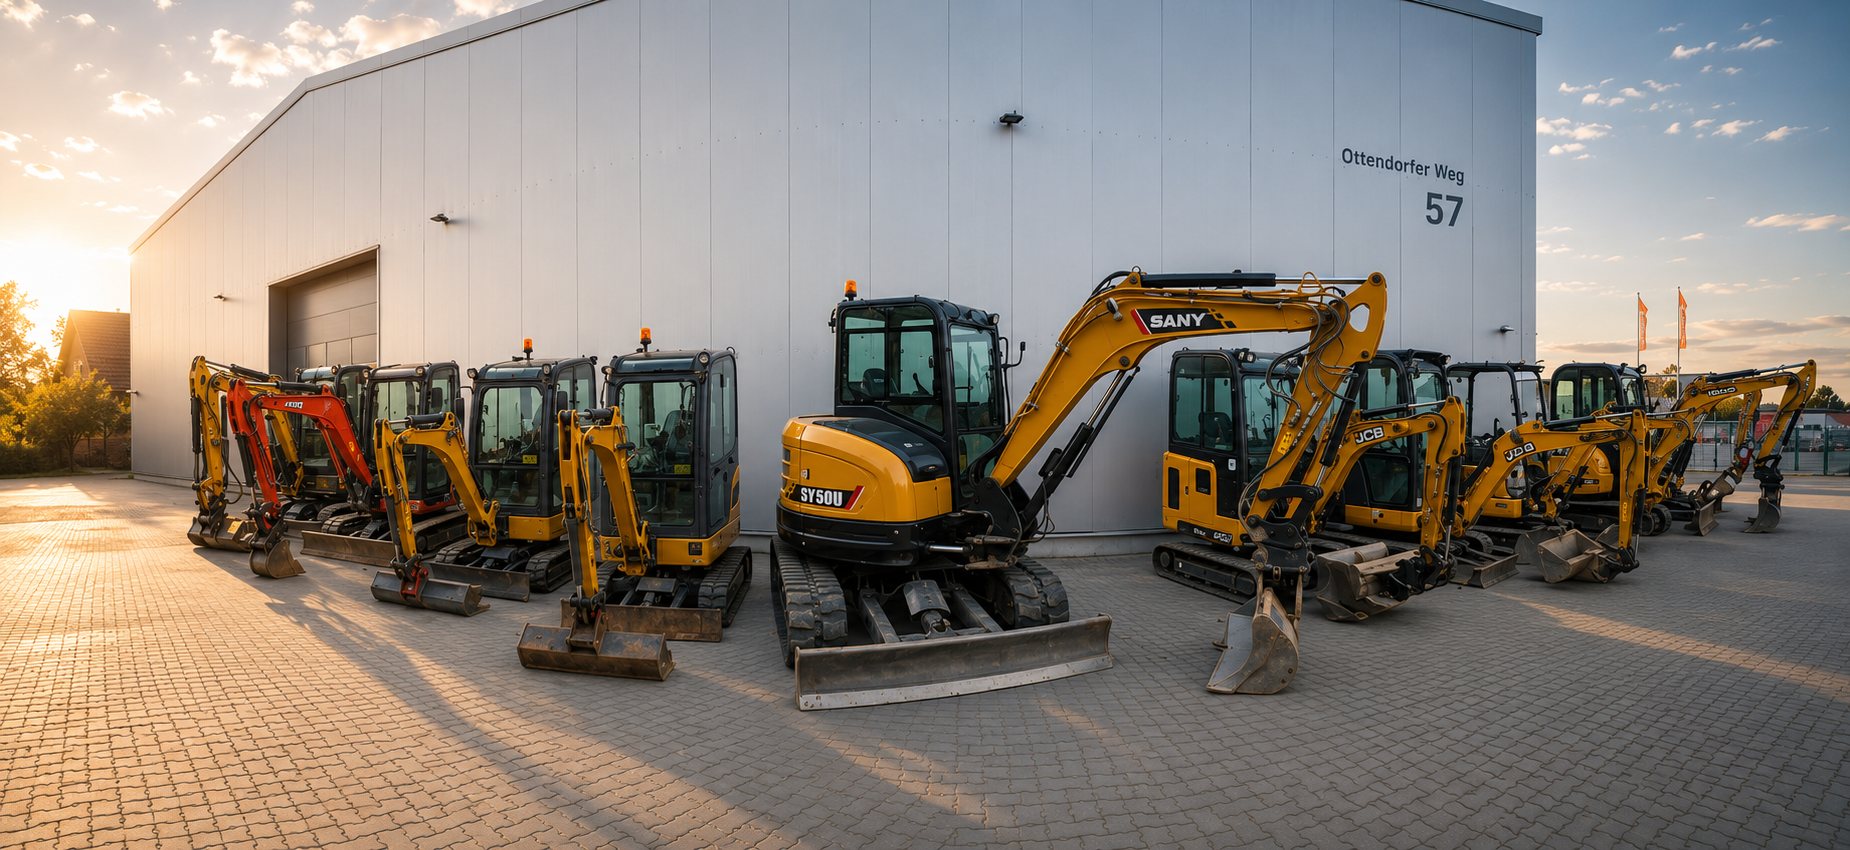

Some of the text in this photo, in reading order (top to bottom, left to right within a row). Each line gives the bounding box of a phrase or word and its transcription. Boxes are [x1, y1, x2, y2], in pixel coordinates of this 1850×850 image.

[1342, 148, 1465, 186] Ottendorfer Weg
[1425, 191, 1464, 227] 57
[1150, 312, 1206, 328] SANY
[1355, 427, 1384, 444] JCB
[800, 487, 843, 507] SY50U
